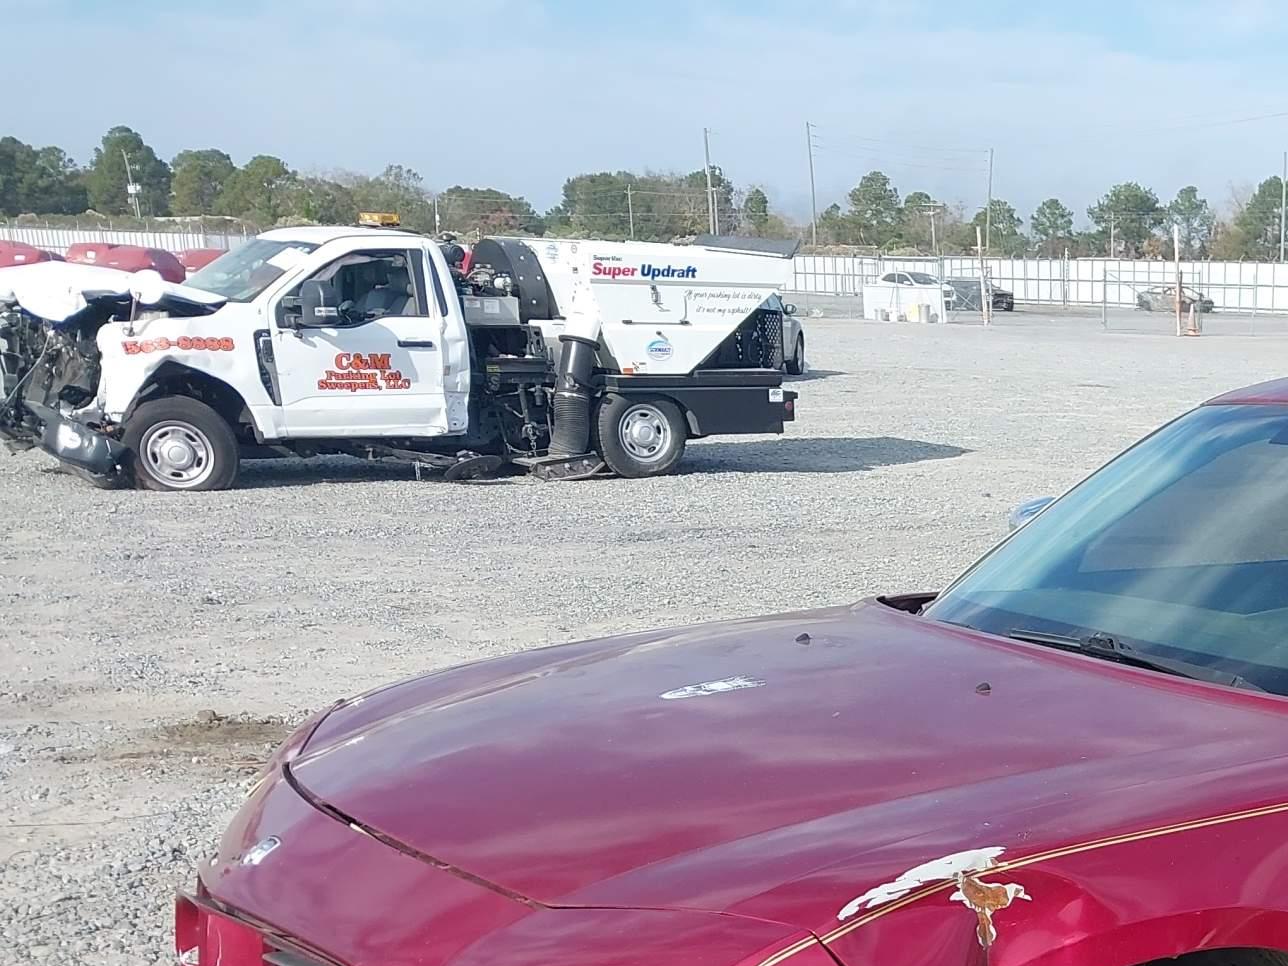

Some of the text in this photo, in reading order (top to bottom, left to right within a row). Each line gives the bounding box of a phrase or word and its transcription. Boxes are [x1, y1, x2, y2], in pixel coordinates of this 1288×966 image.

[592, 262, 697, 279] Super Updraft
[335, 353, 391, 370] C&M
[326, 370, 402, 382] Parking Lot
